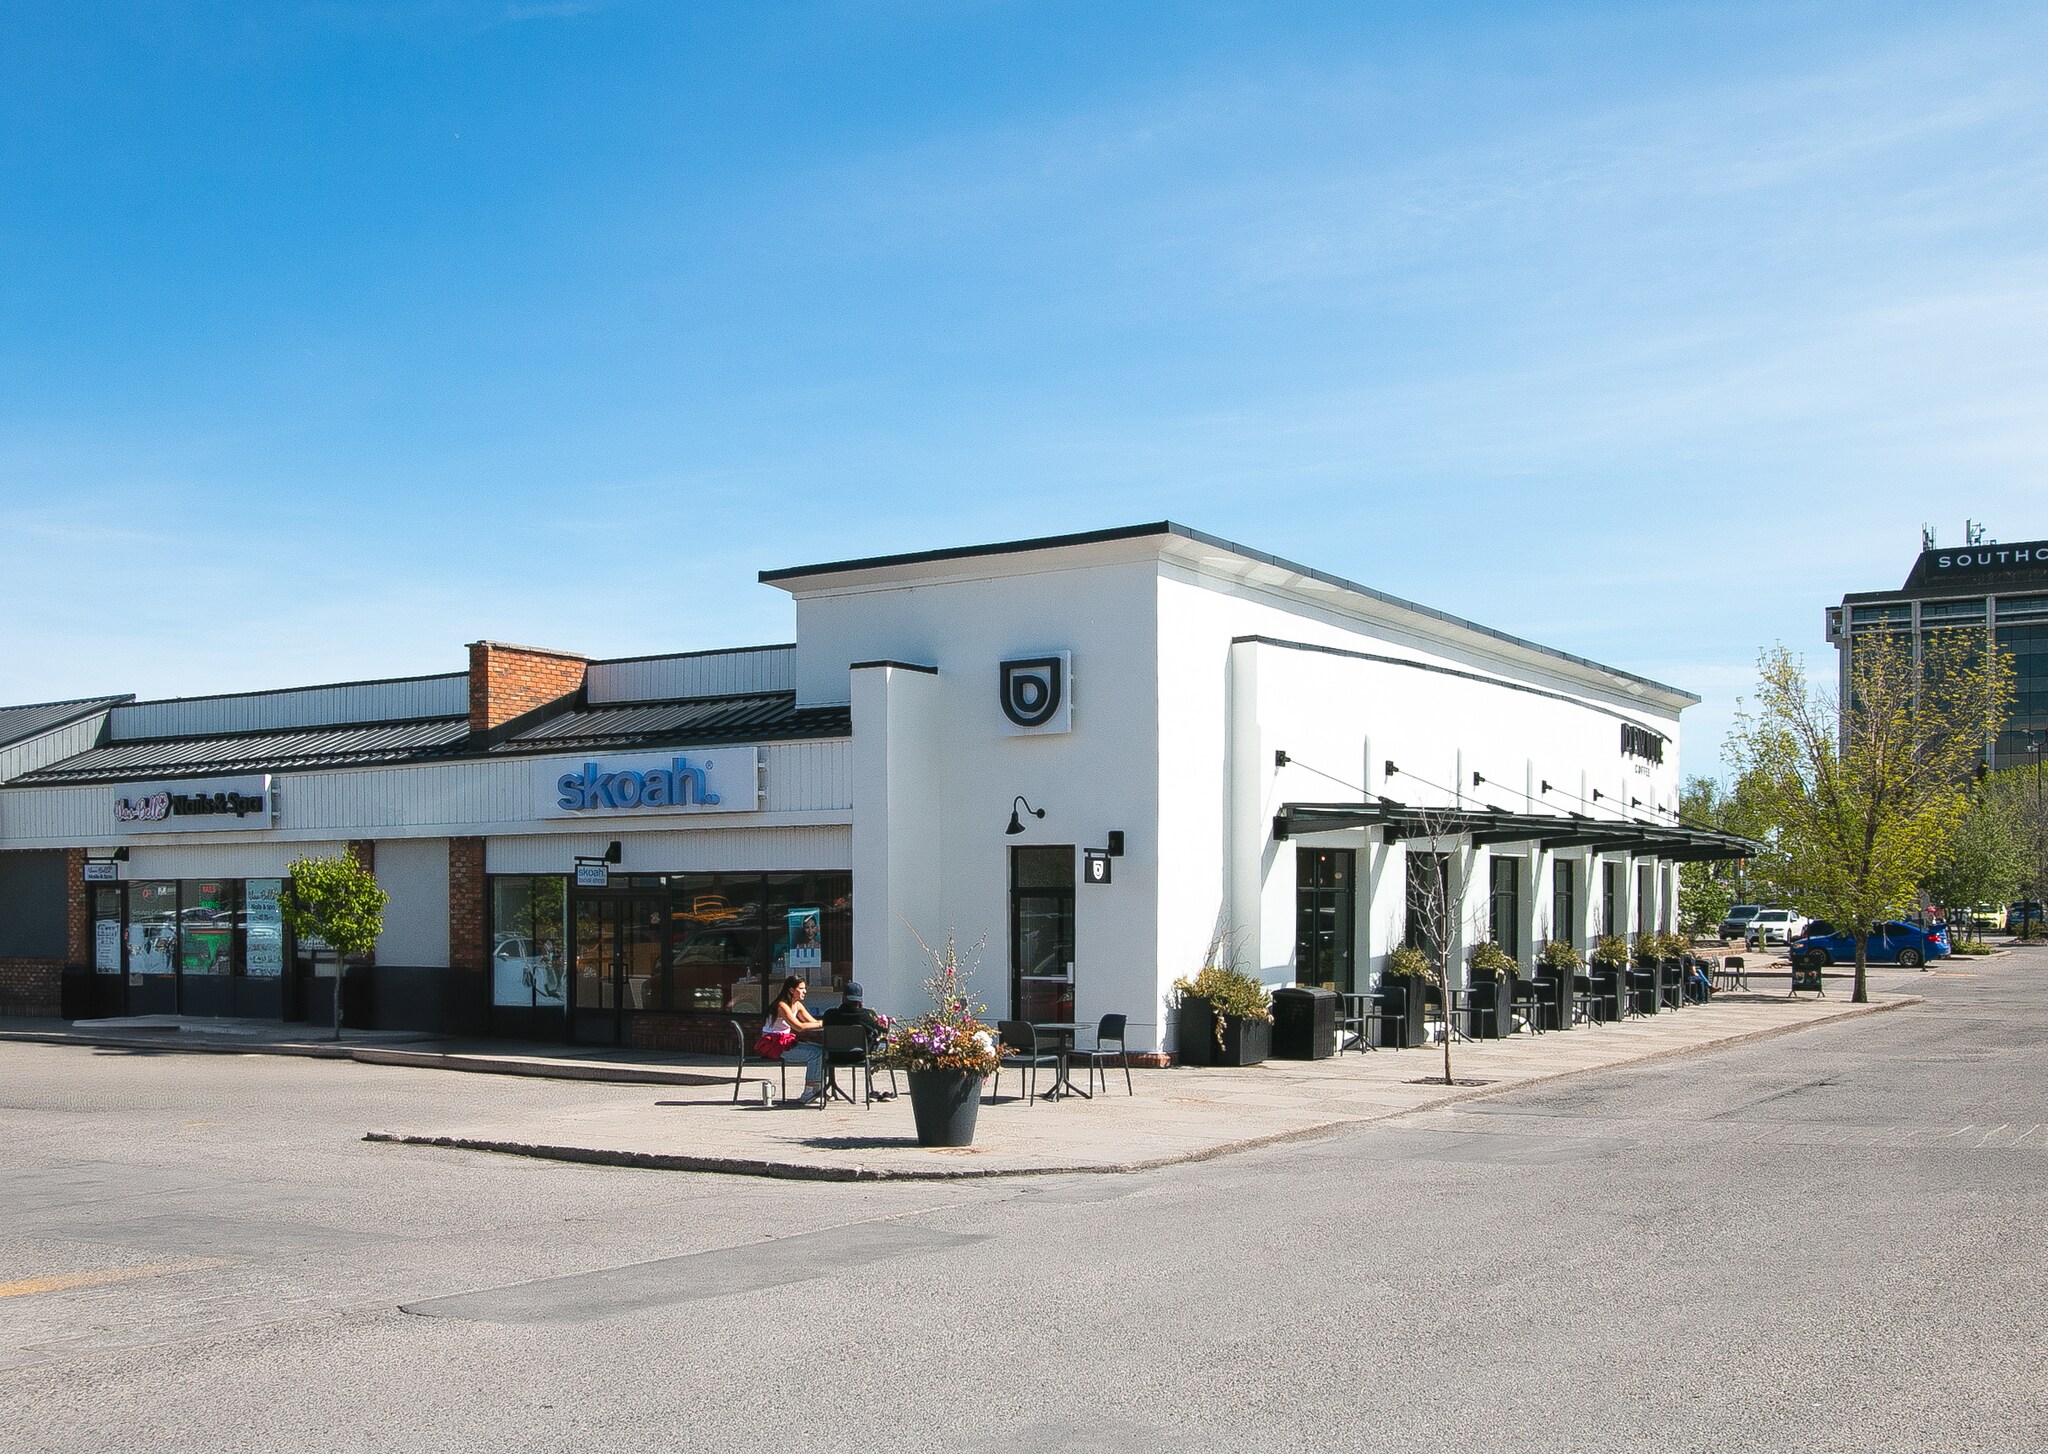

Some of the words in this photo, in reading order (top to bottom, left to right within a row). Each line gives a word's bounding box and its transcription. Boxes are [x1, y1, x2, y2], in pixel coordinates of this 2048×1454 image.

[1938, 548, 2048, 568] SOUTHC
[173, 793, 213, 815] Nails
[213, 792, 228, 814] &
[227, 791, 263, 818] Spa
